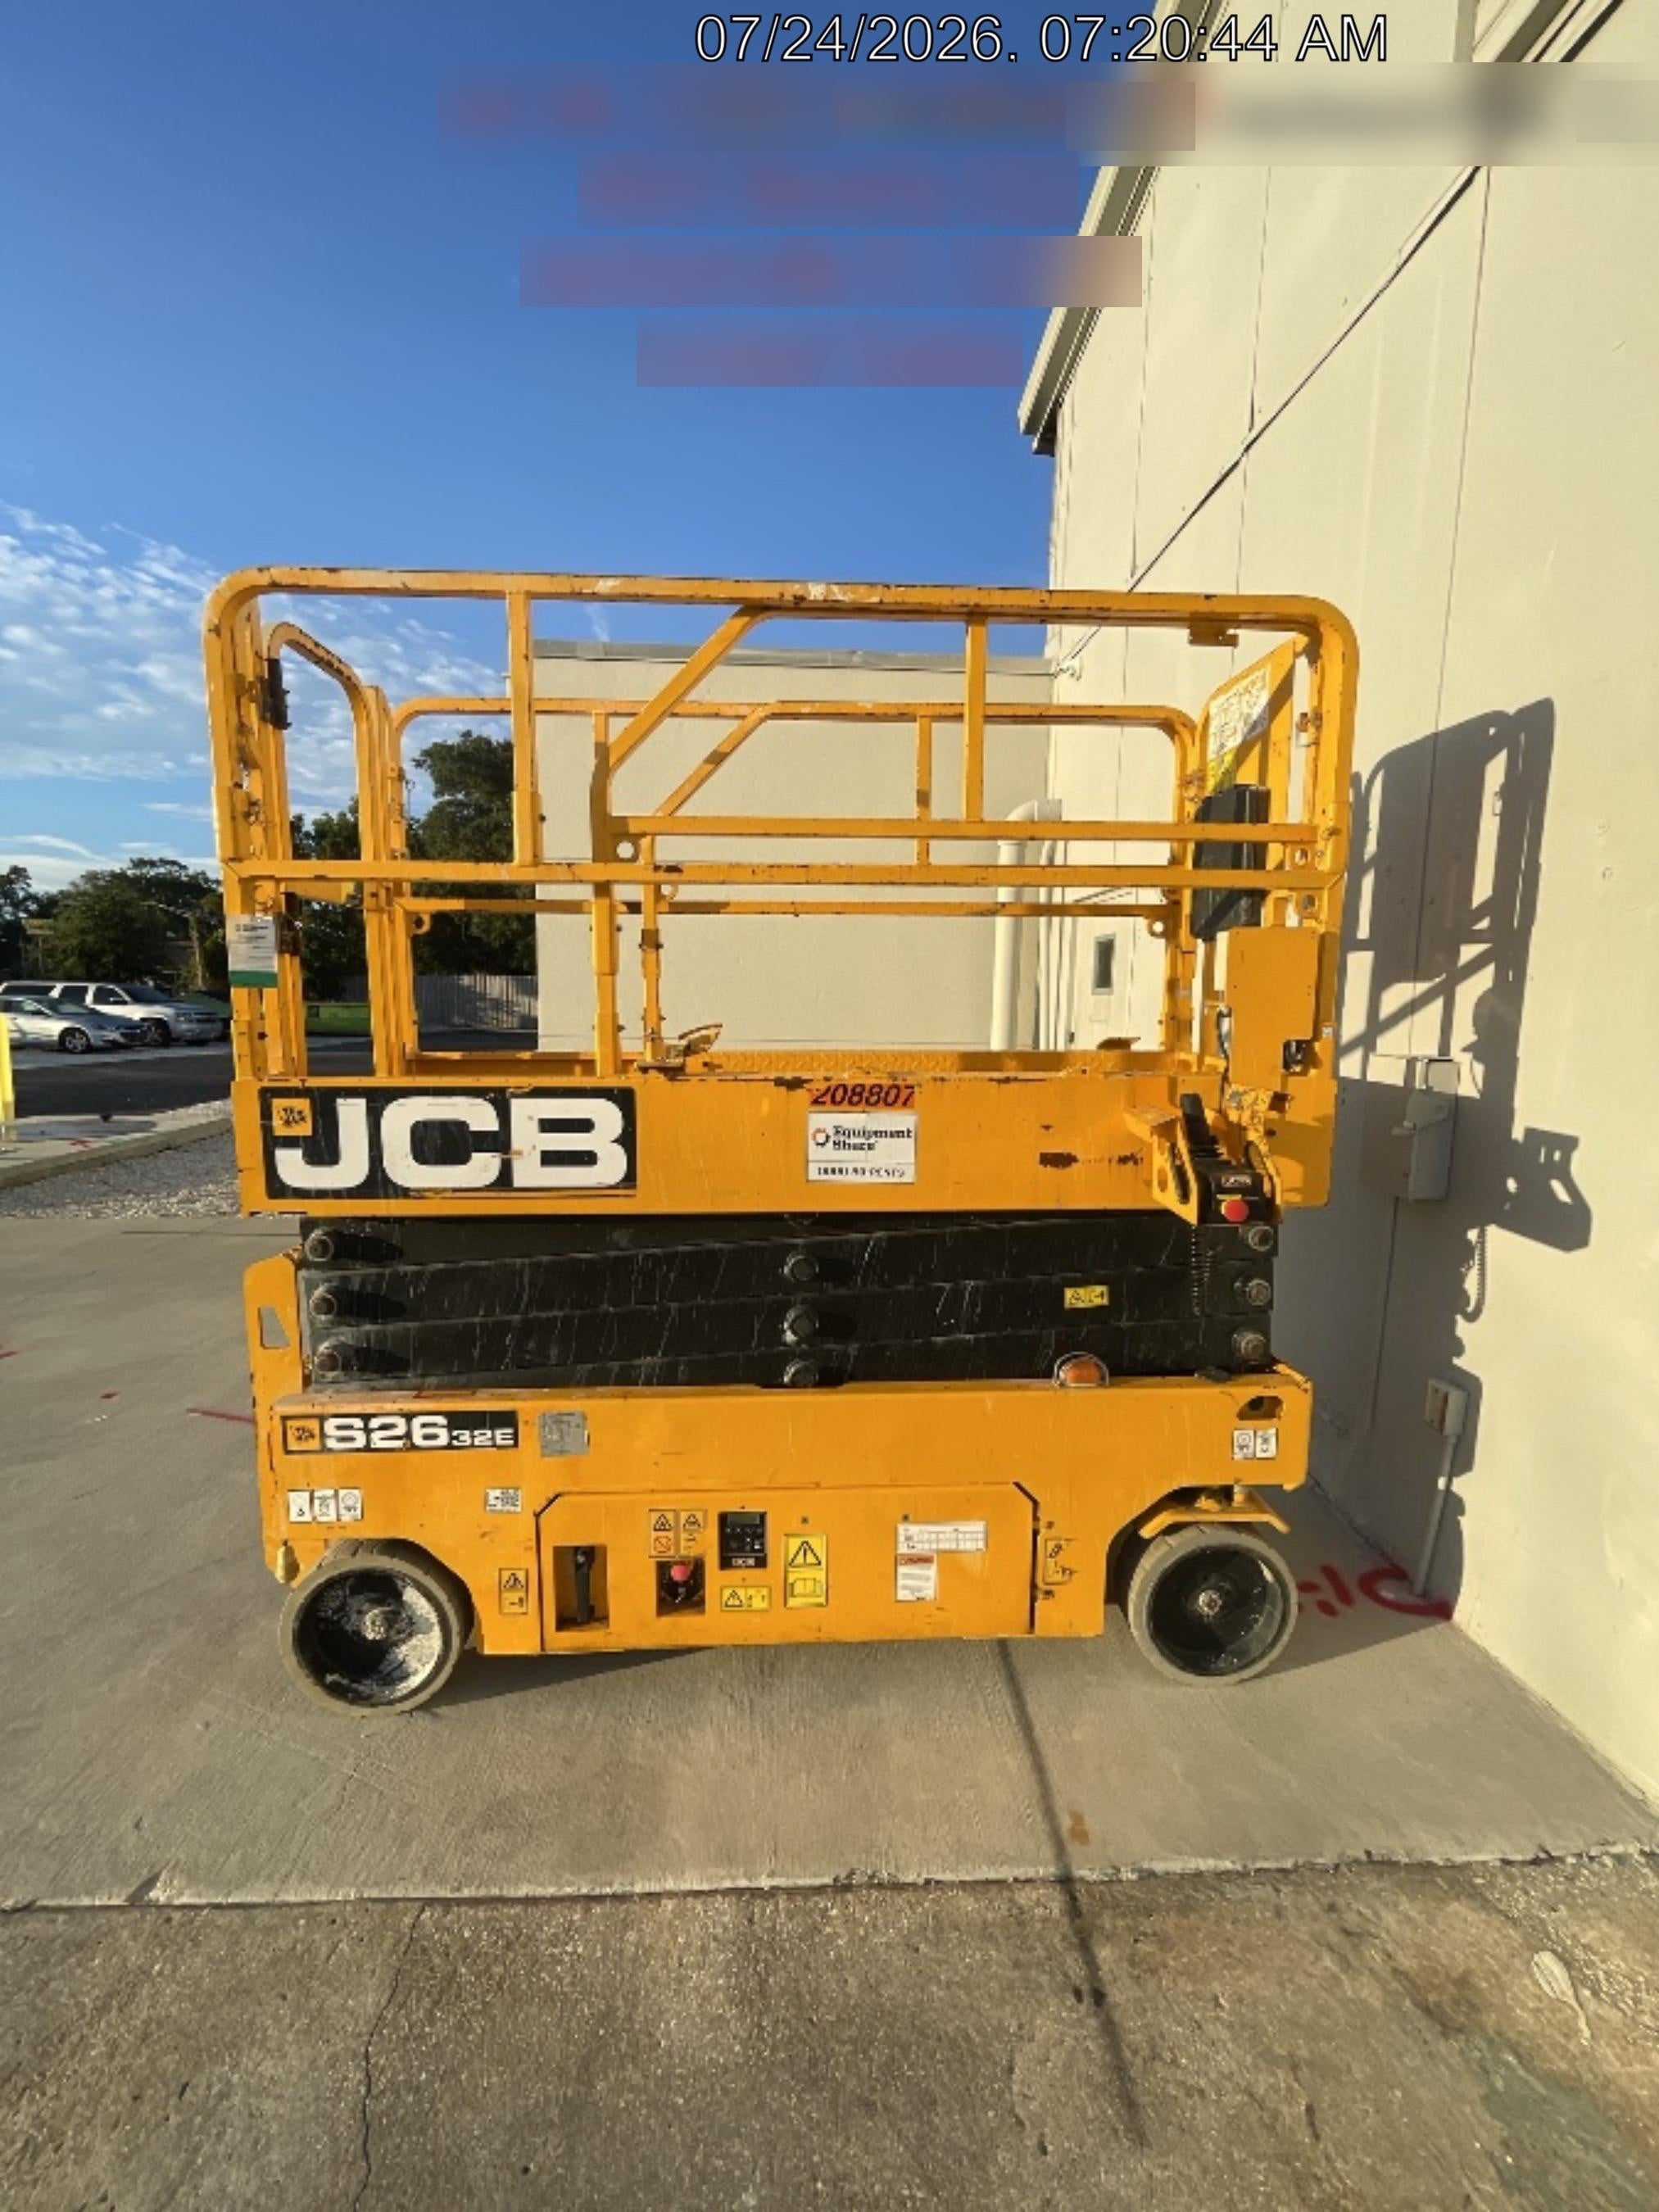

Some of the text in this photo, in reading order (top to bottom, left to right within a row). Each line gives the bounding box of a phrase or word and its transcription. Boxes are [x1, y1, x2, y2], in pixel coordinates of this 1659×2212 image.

[811, 1083, 915, 1106] 208807
[274, 1095, 628, 1189] JCB
[832, 1125, 912, 1140] Equipment
